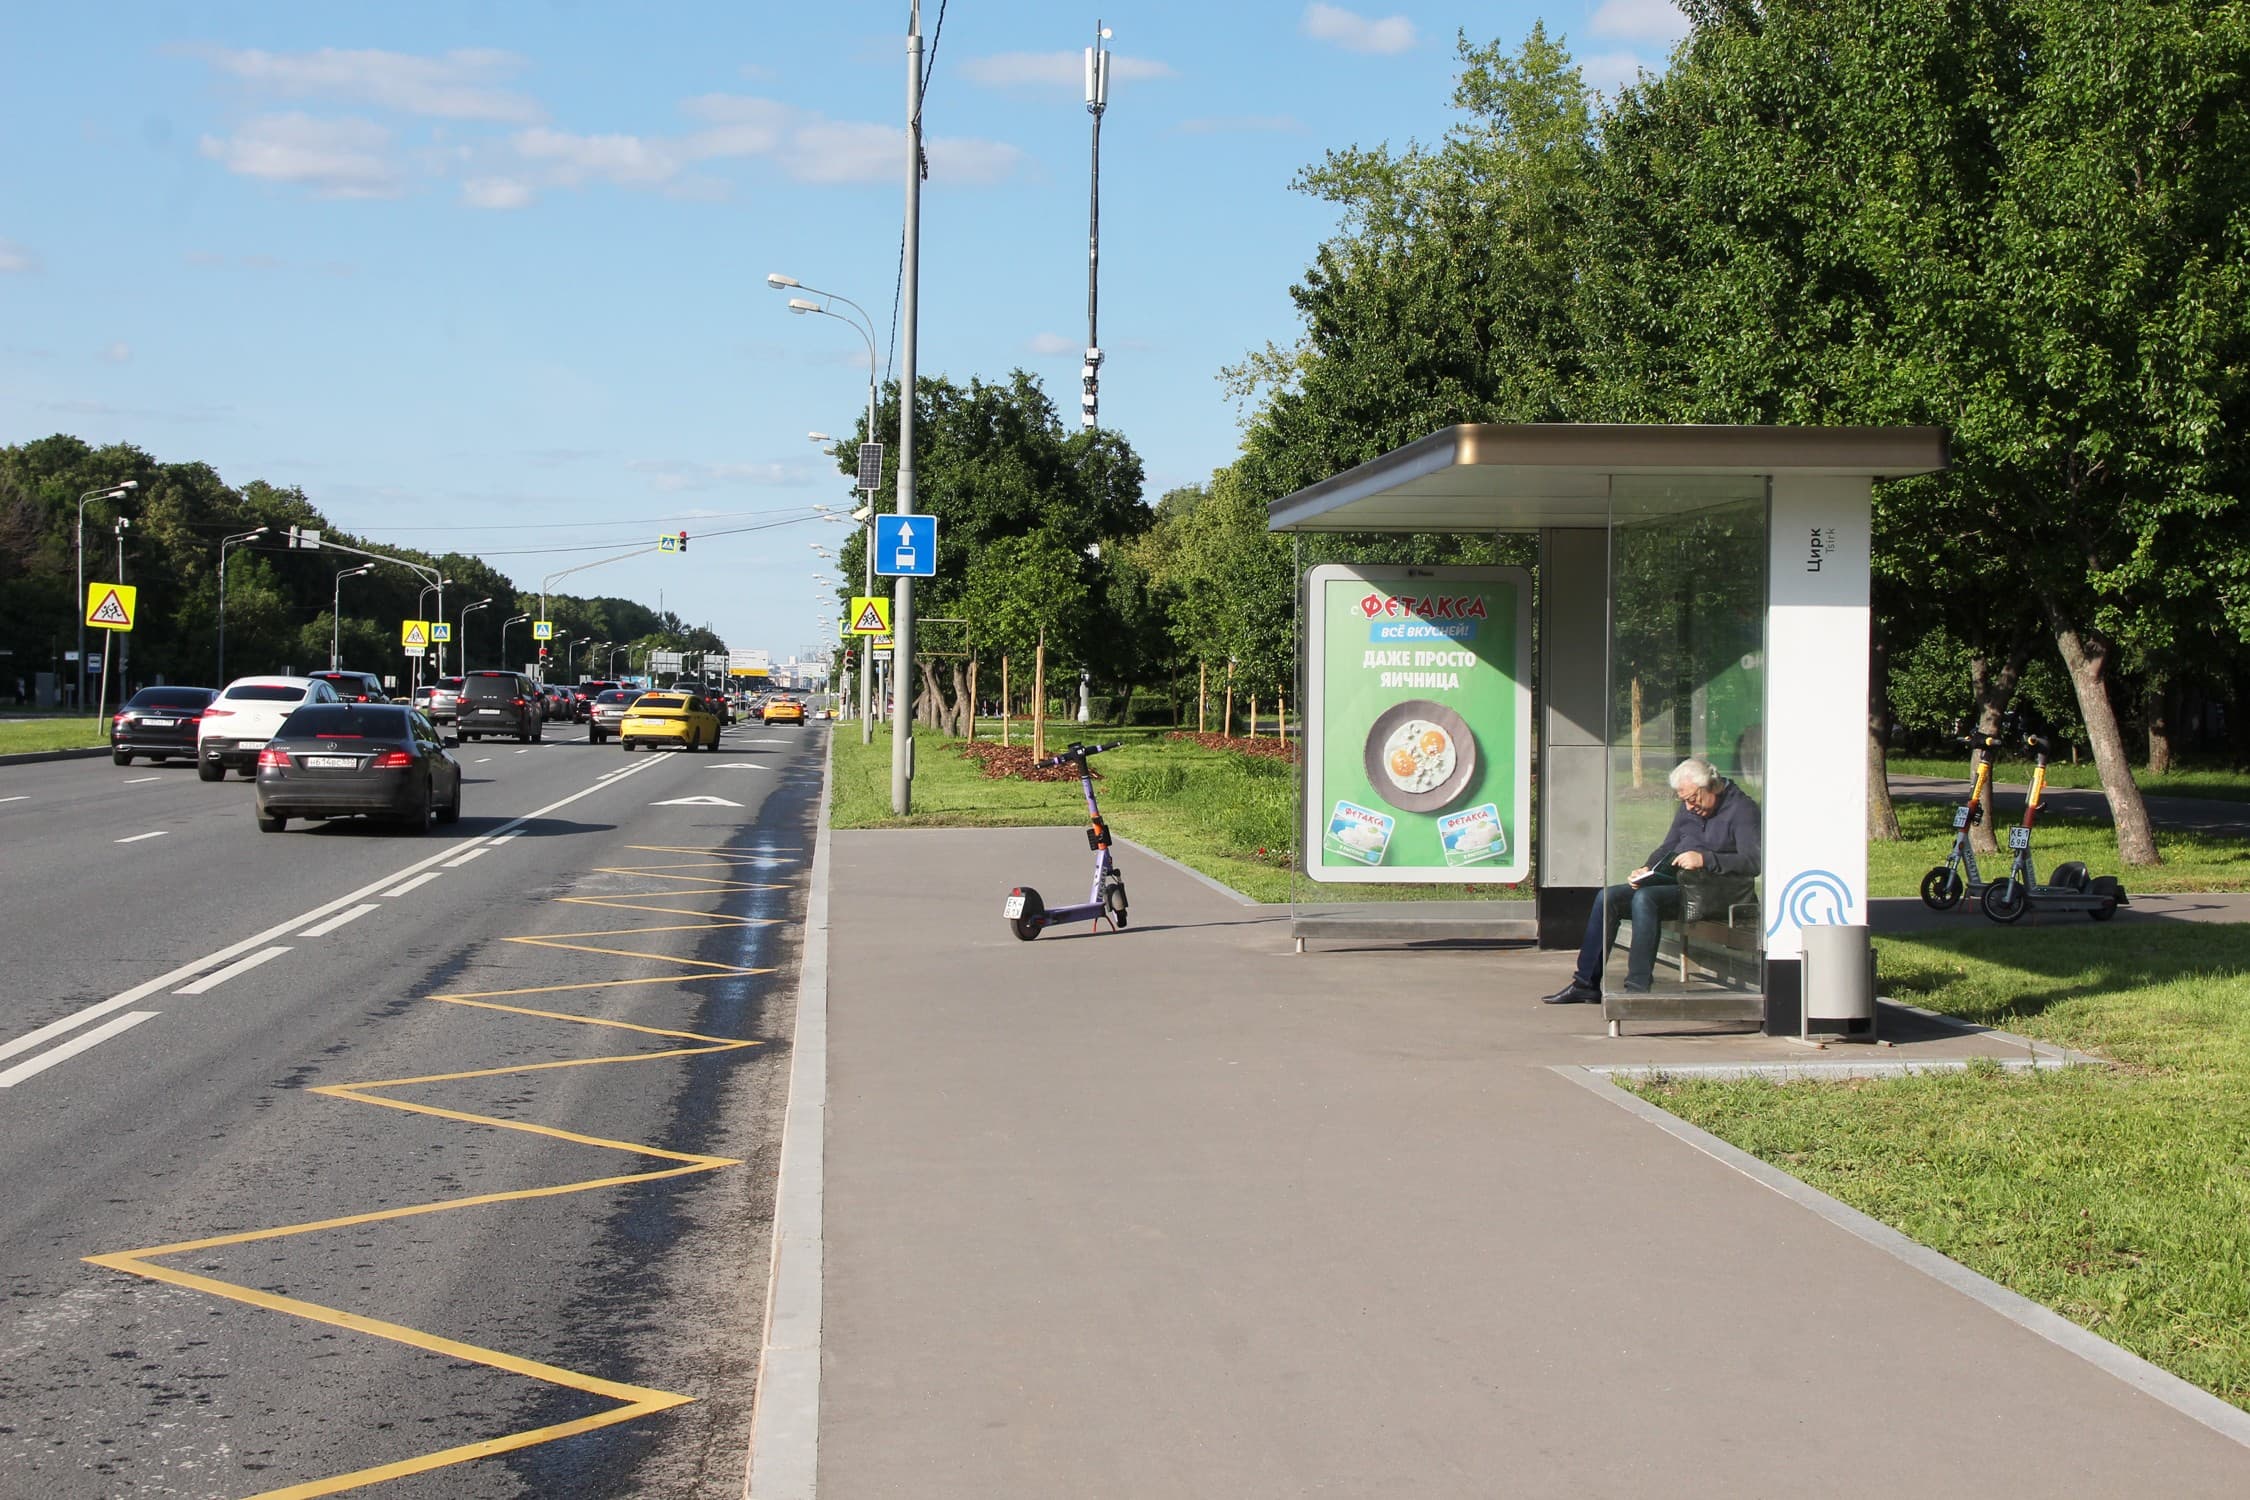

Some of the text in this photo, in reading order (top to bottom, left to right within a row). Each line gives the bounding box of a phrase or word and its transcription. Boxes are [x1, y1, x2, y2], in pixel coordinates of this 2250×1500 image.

[1807, 528, 1823, 572] Цирк
[1825, 528, 1835, 554] Tsirk
[1360, 592, 1488, 619] ФЕТАКСА
[1381, 622, 1469, 638] ВСЁ ВКУСНЕЙ!
[1363, 651, 1477, 668] ДАЖЕ ПРОСТО
[1380, 672, 1459, 690] ЯИЧНИЦА
